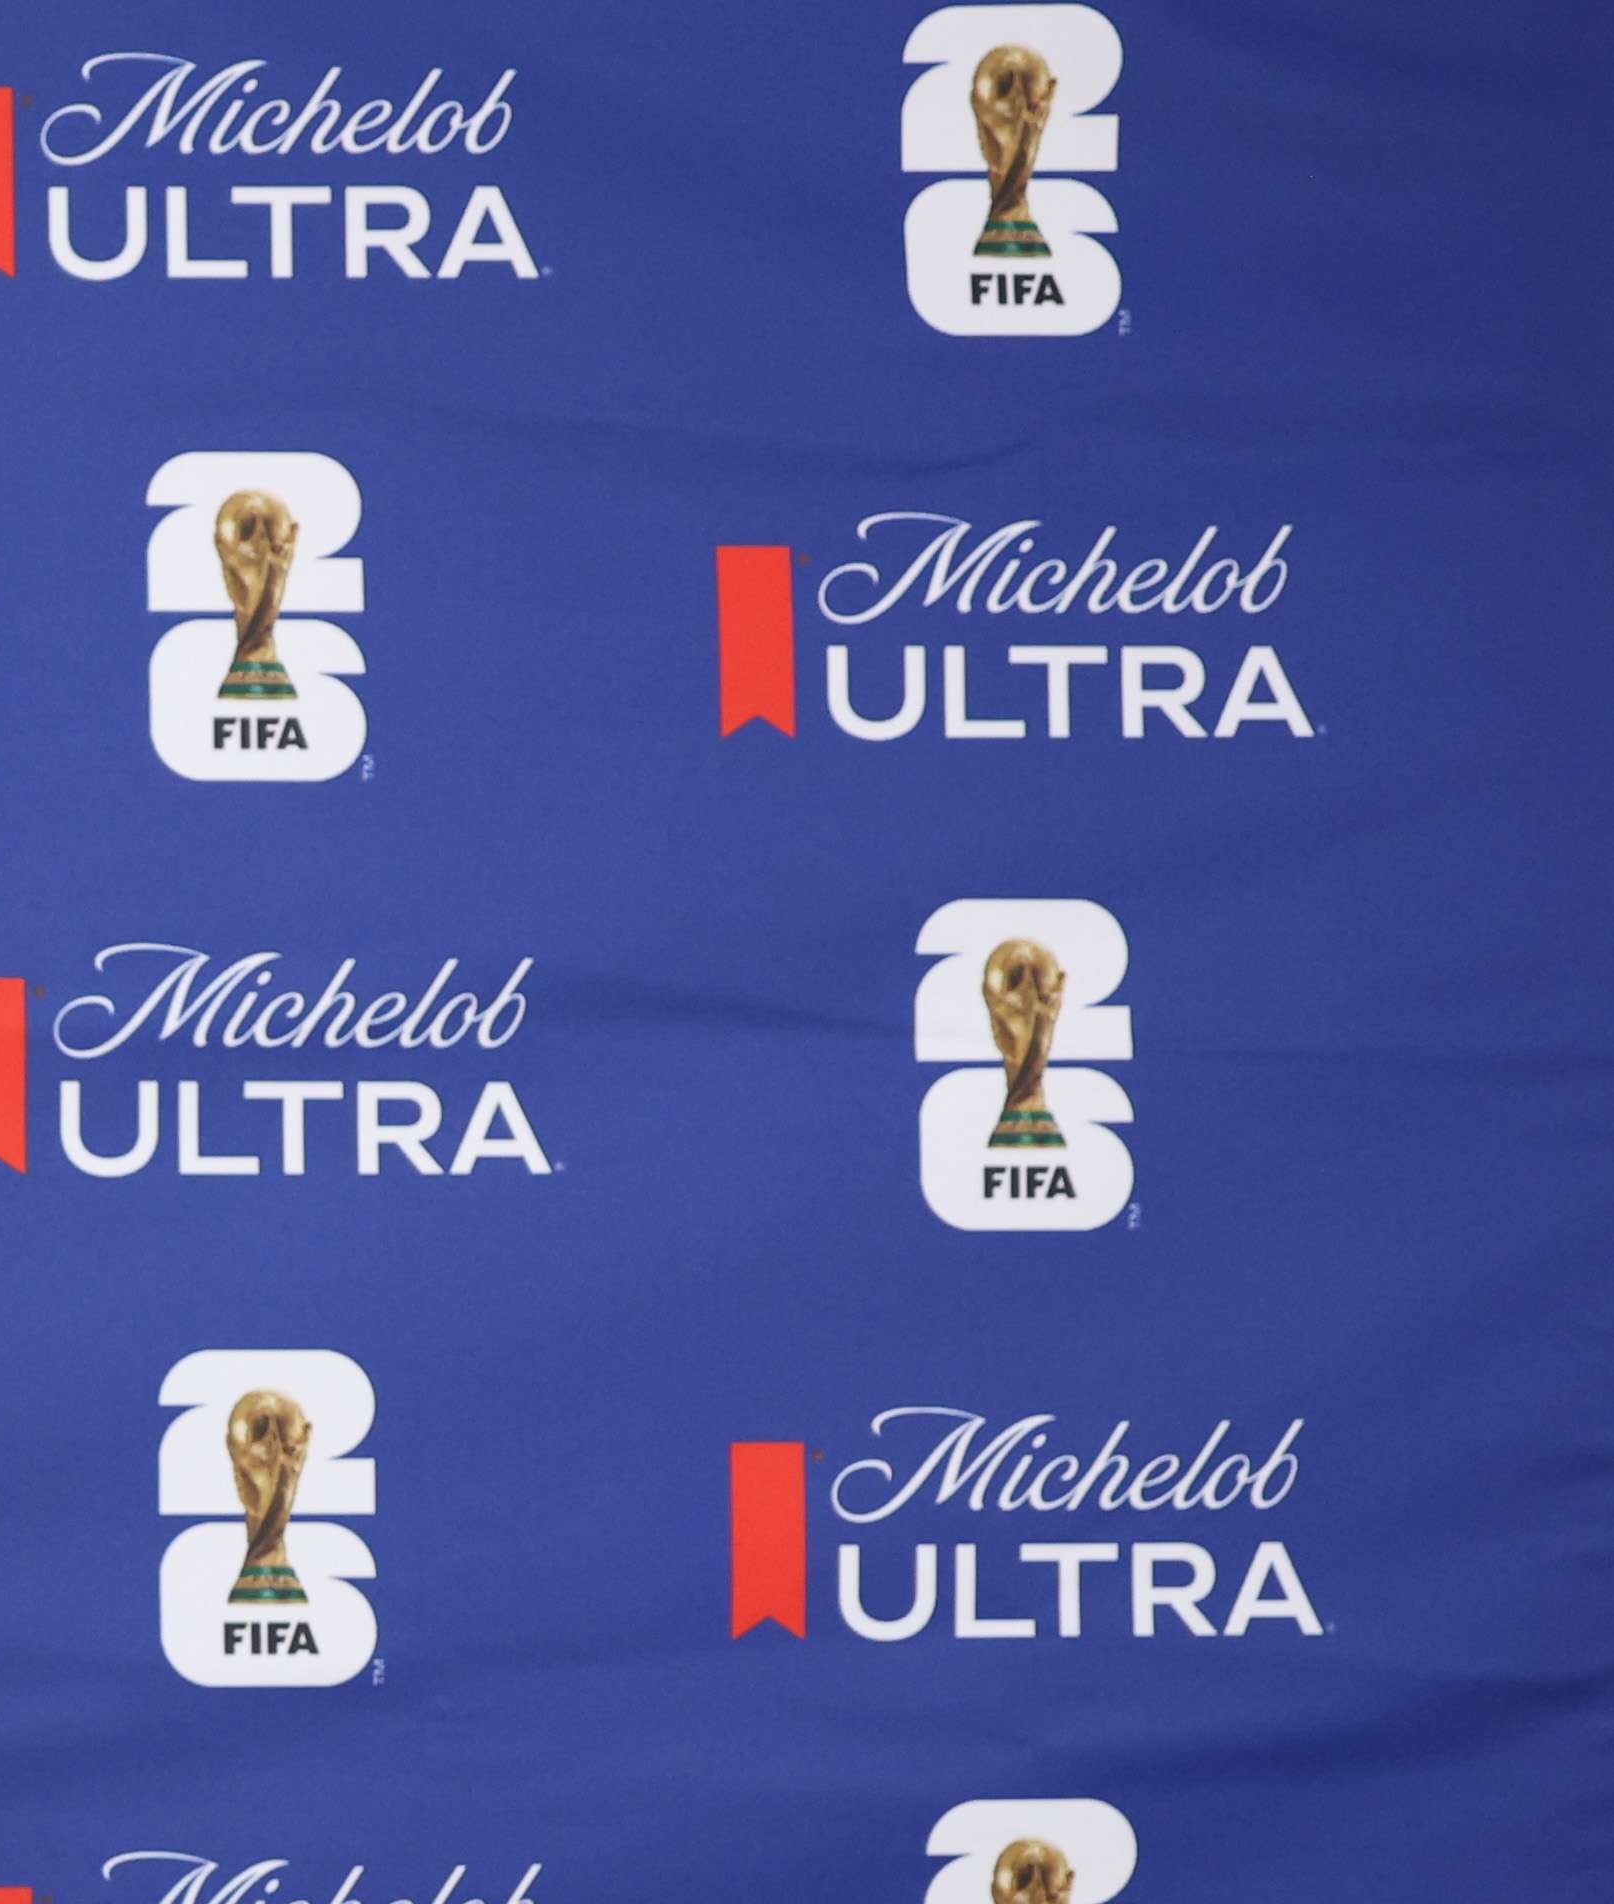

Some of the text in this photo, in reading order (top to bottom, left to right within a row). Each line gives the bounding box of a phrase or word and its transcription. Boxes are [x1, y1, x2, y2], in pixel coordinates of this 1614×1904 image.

[40, 52, 517, 166] Michelob
[47, 185, 539, 282] ULTRA
[970, 273, 1065, 306] FIFA
[817, 512, 1292, 625] Michelob
[213, 717, 308, 750] FIFA
[826, 645, 1315, 742] ULTRA
[53, 943, 534, 1059] Michelob
[59, 1080, 552, 1178] ULTRA
[983, 1166, 1076, 1199] FIFA
[830, 1407, 1304, 1523] Michelob
[223, 1622, 319, 1655] FIFA
[838, 1541, 1324, 1642] ULTRA
